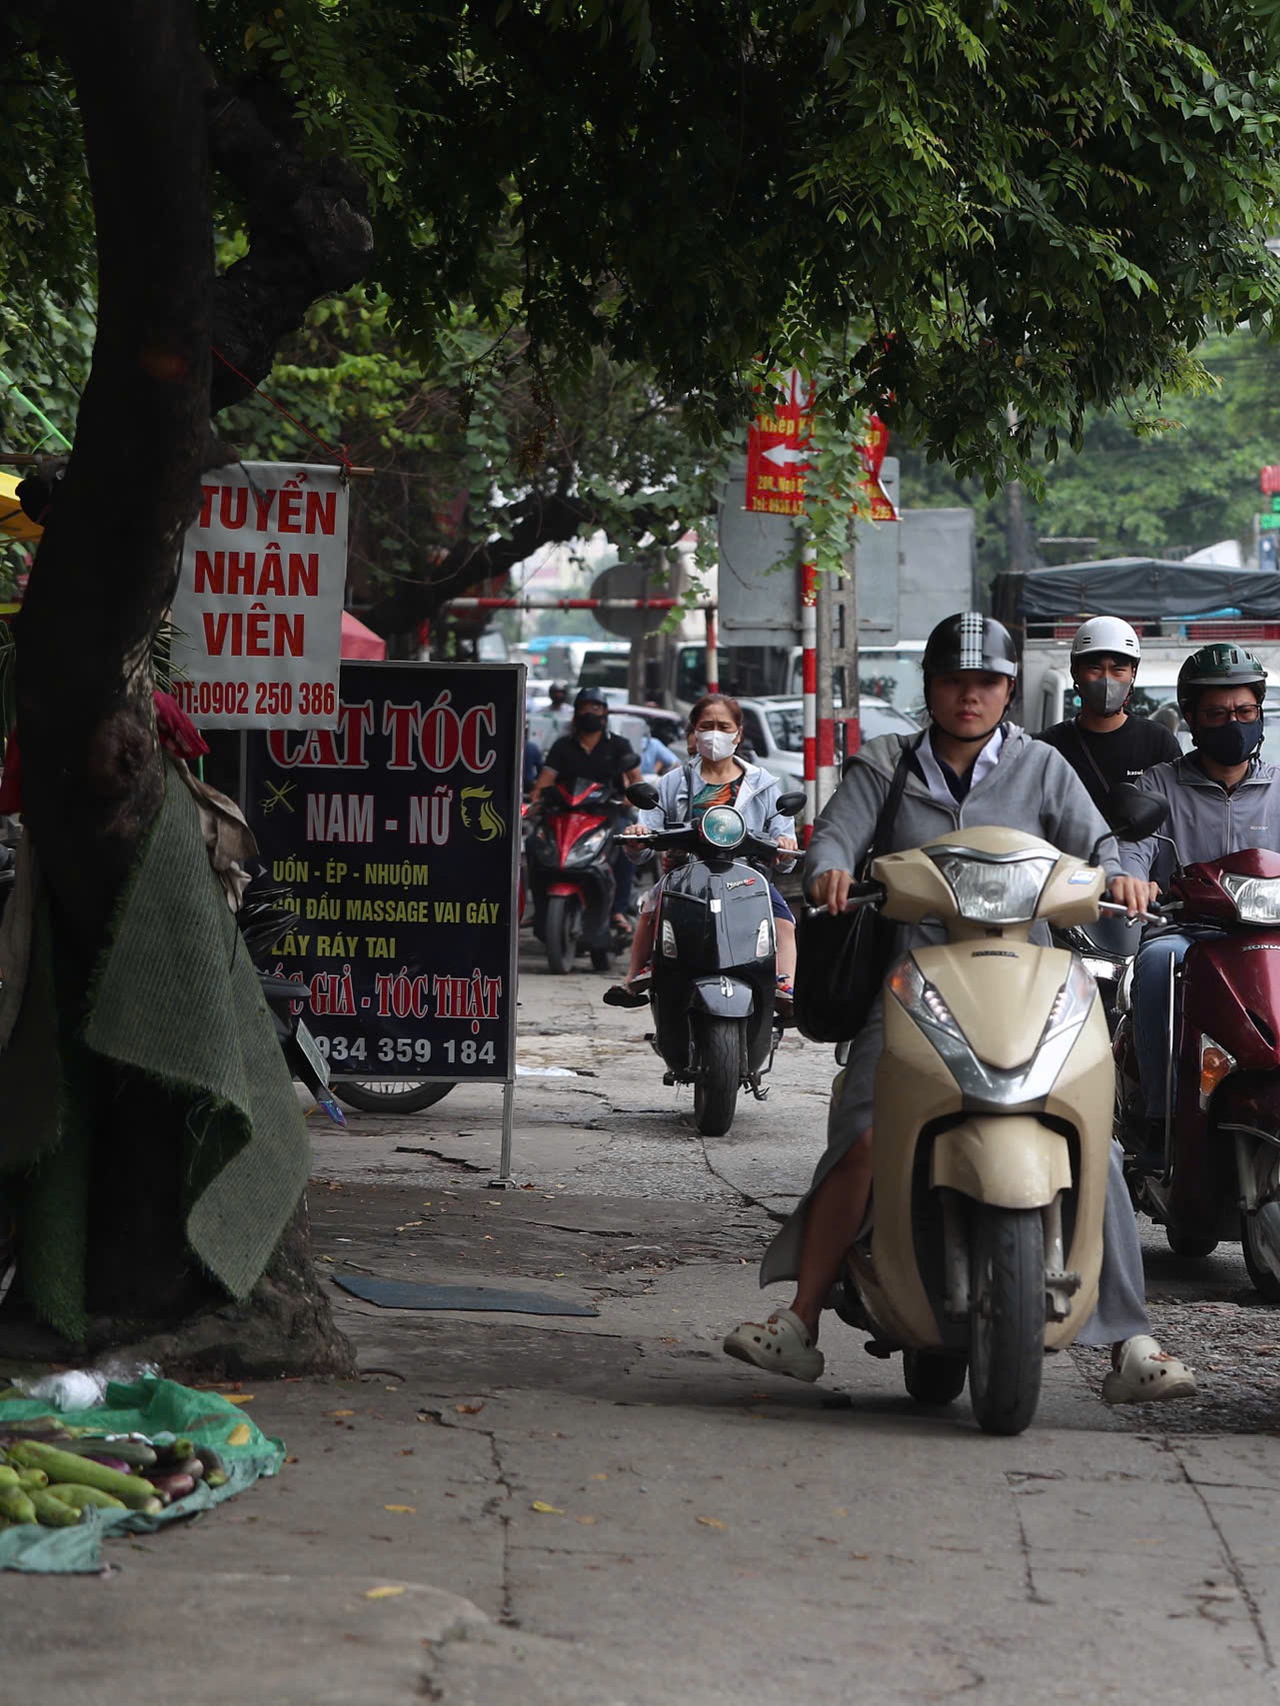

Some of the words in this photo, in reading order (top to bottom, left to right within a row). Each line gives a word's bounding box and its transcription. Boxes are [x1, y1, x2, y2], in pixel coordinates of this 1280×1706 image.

[199, 471, 337, 536] TUYỂN
[194, 541, 319, 597] NHÂN
[202, 602, 305, 657] VIÊN
[255, 682, 292, 715] 250
[299, 682, 335, 715] 386
[382, 689, 496, 774] TÓC
[307, 793, 374, 843] NAM
[409, 784, 453, 845] NỮ
[273, 854, 309, 883] UỐN
[326, 858, 348, 883] ÉP
[365, 860, 429, 890] NHUỘM
[306, 891, 341, 921] ĐẦU
[346, 899, 429, 923] MASSAGE
[434, 902, 461, 923] VAI
[466, 898, 500, 924] GÁY
[317, 931, 359, 958] RÁY
[365, 937, 396, 958] TAI
[310, 964, 357, 1016] GIẢ
[375, 965, 429, 1019] TÓC
[433, 967, 502, 1034] THẬT
[314, 1035, 367, 1060] 934
[378, 1037, 431, 1063] 359
[443, 1039, 496, 1064] 184
